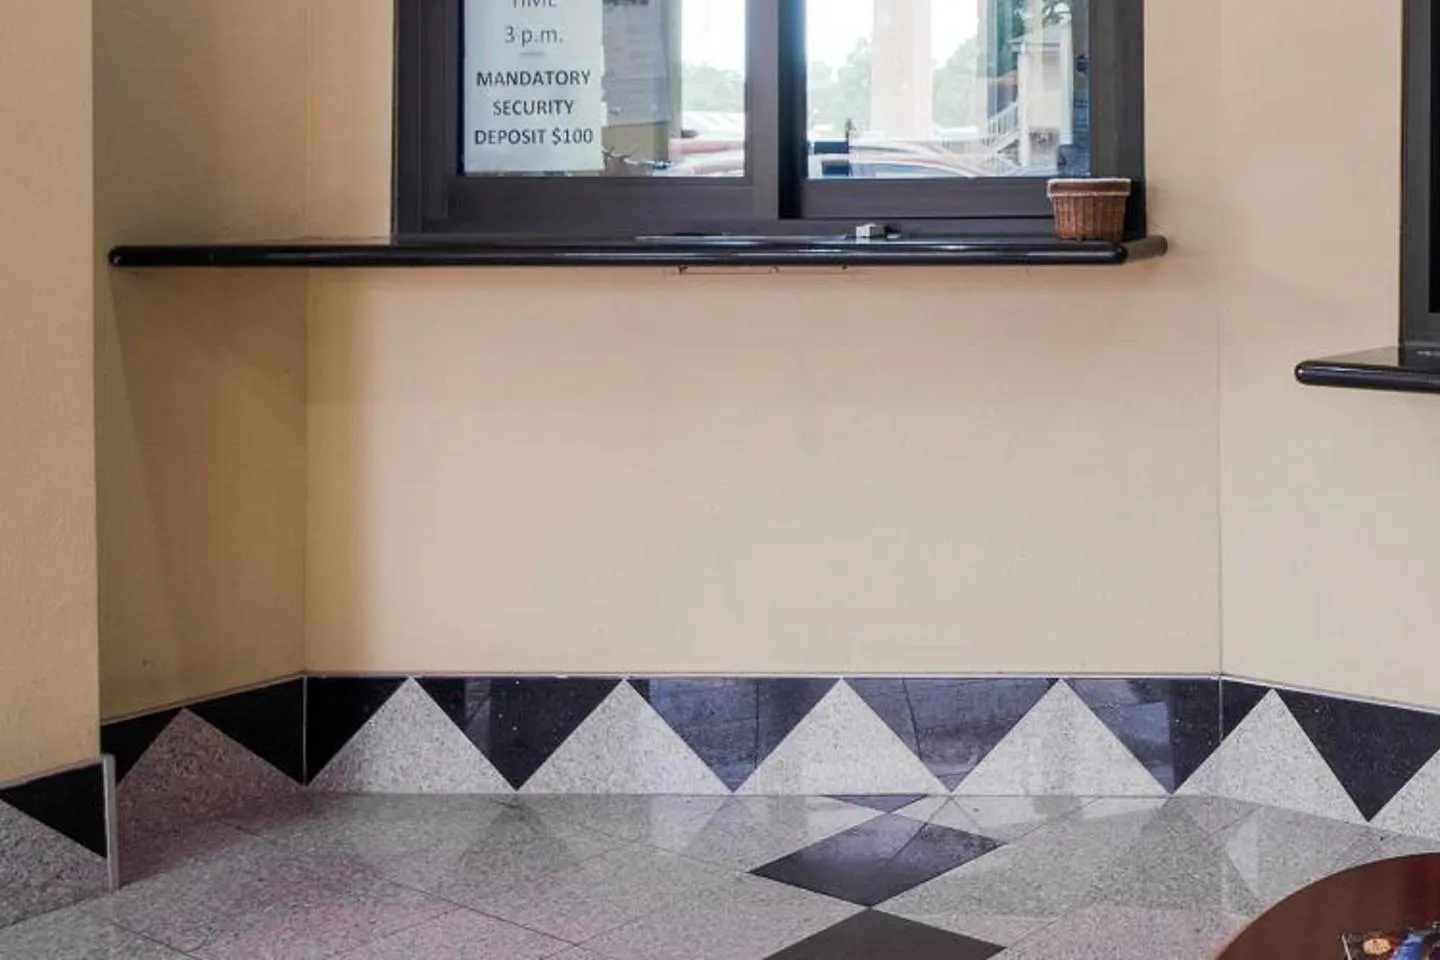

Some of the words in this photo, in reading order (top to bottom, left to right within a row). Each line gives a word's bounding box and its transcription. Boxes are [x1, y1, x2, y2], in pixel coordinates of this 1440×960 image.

[504, 25, 516, 43] 3
[521, 28, 564, 48] p.m.
[475, 69, 591, 87] MANDATORY
[492, 98, 575, 116] SECURITY
[474, 128, 546, 145] DEPOSIT
[551, 126, 594, 146] $100
